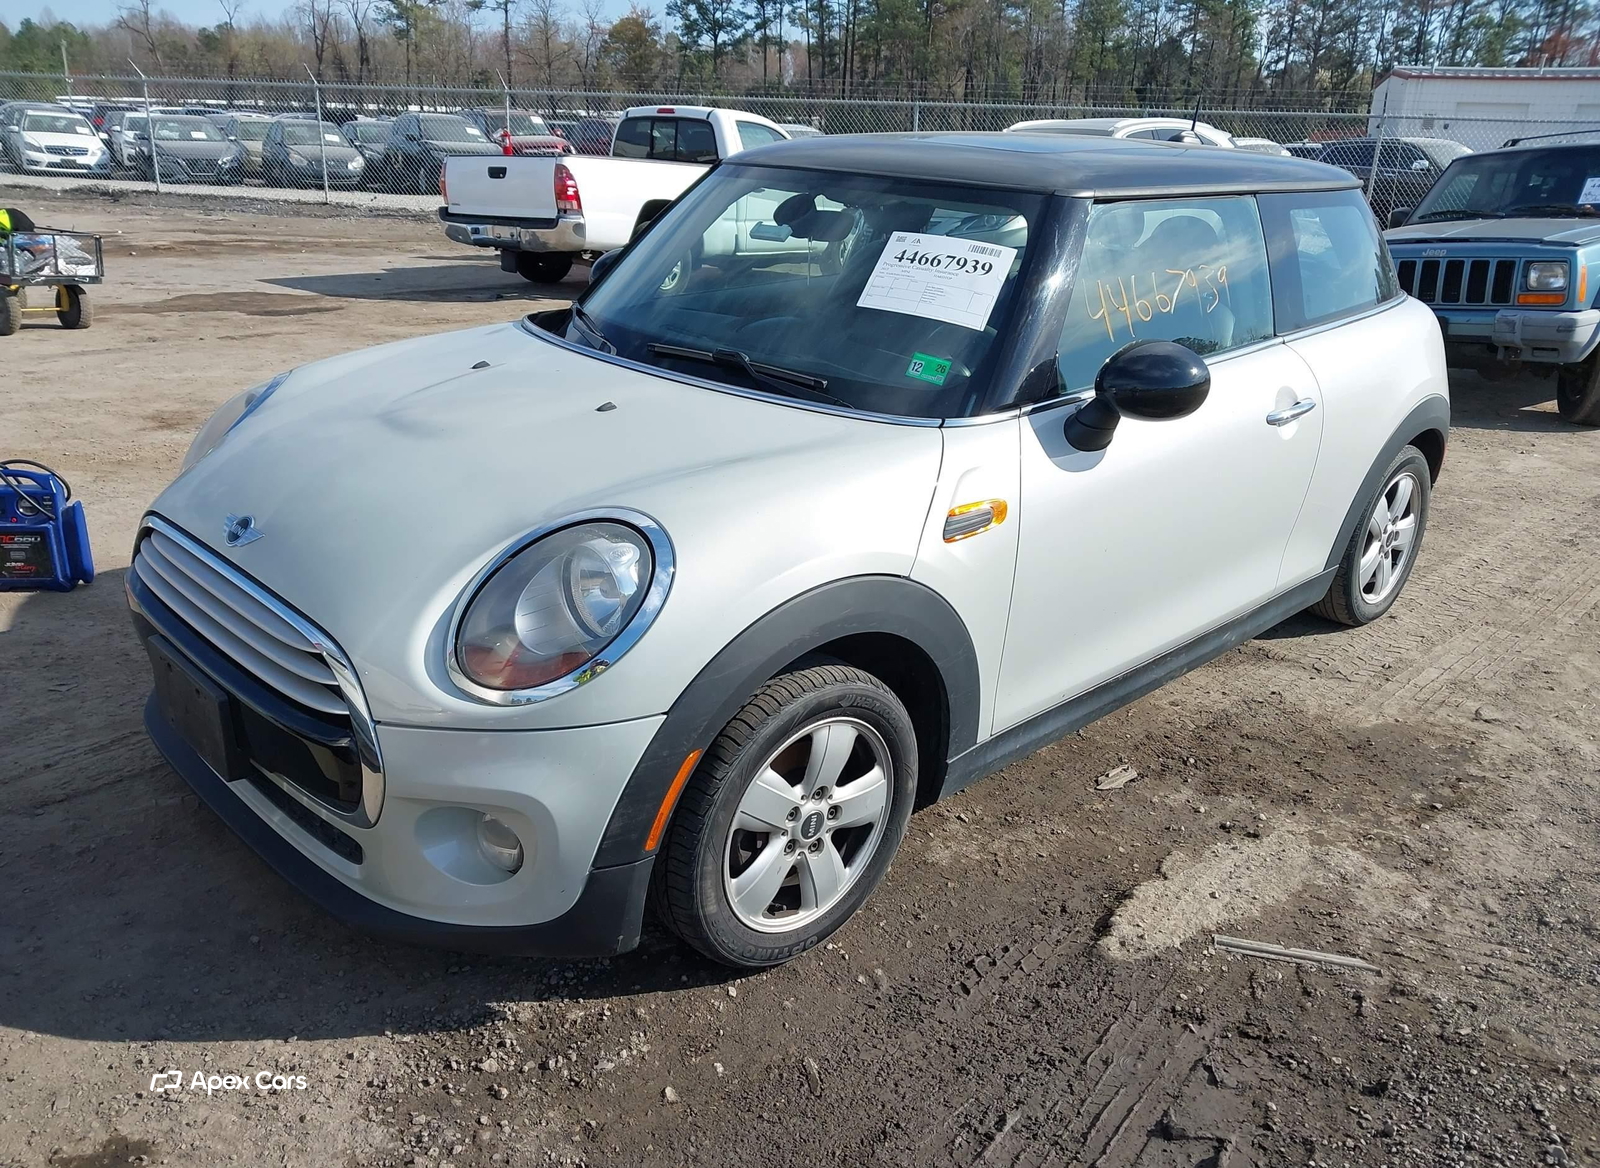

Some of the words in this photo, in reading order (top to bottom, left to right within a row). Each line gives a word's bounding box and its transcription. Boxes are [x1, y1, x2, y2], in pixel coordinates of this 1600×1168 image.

[893, 248, 993, 276] 44667939
[1422, 248, 1447, 257] Jeep
[882, 261, 911, 270] Progressive
[912, 264, 934, 273] Casualty
[935, 268, 959, 277] Insurance
[1082, 265, 1231, 342] 44667939
[911, 361, 924, 373] 12
[934, 363, 948, 375] 26
[807, 814, 818, 837] MINI
[741, 935, 819, 961] OPTIMO
